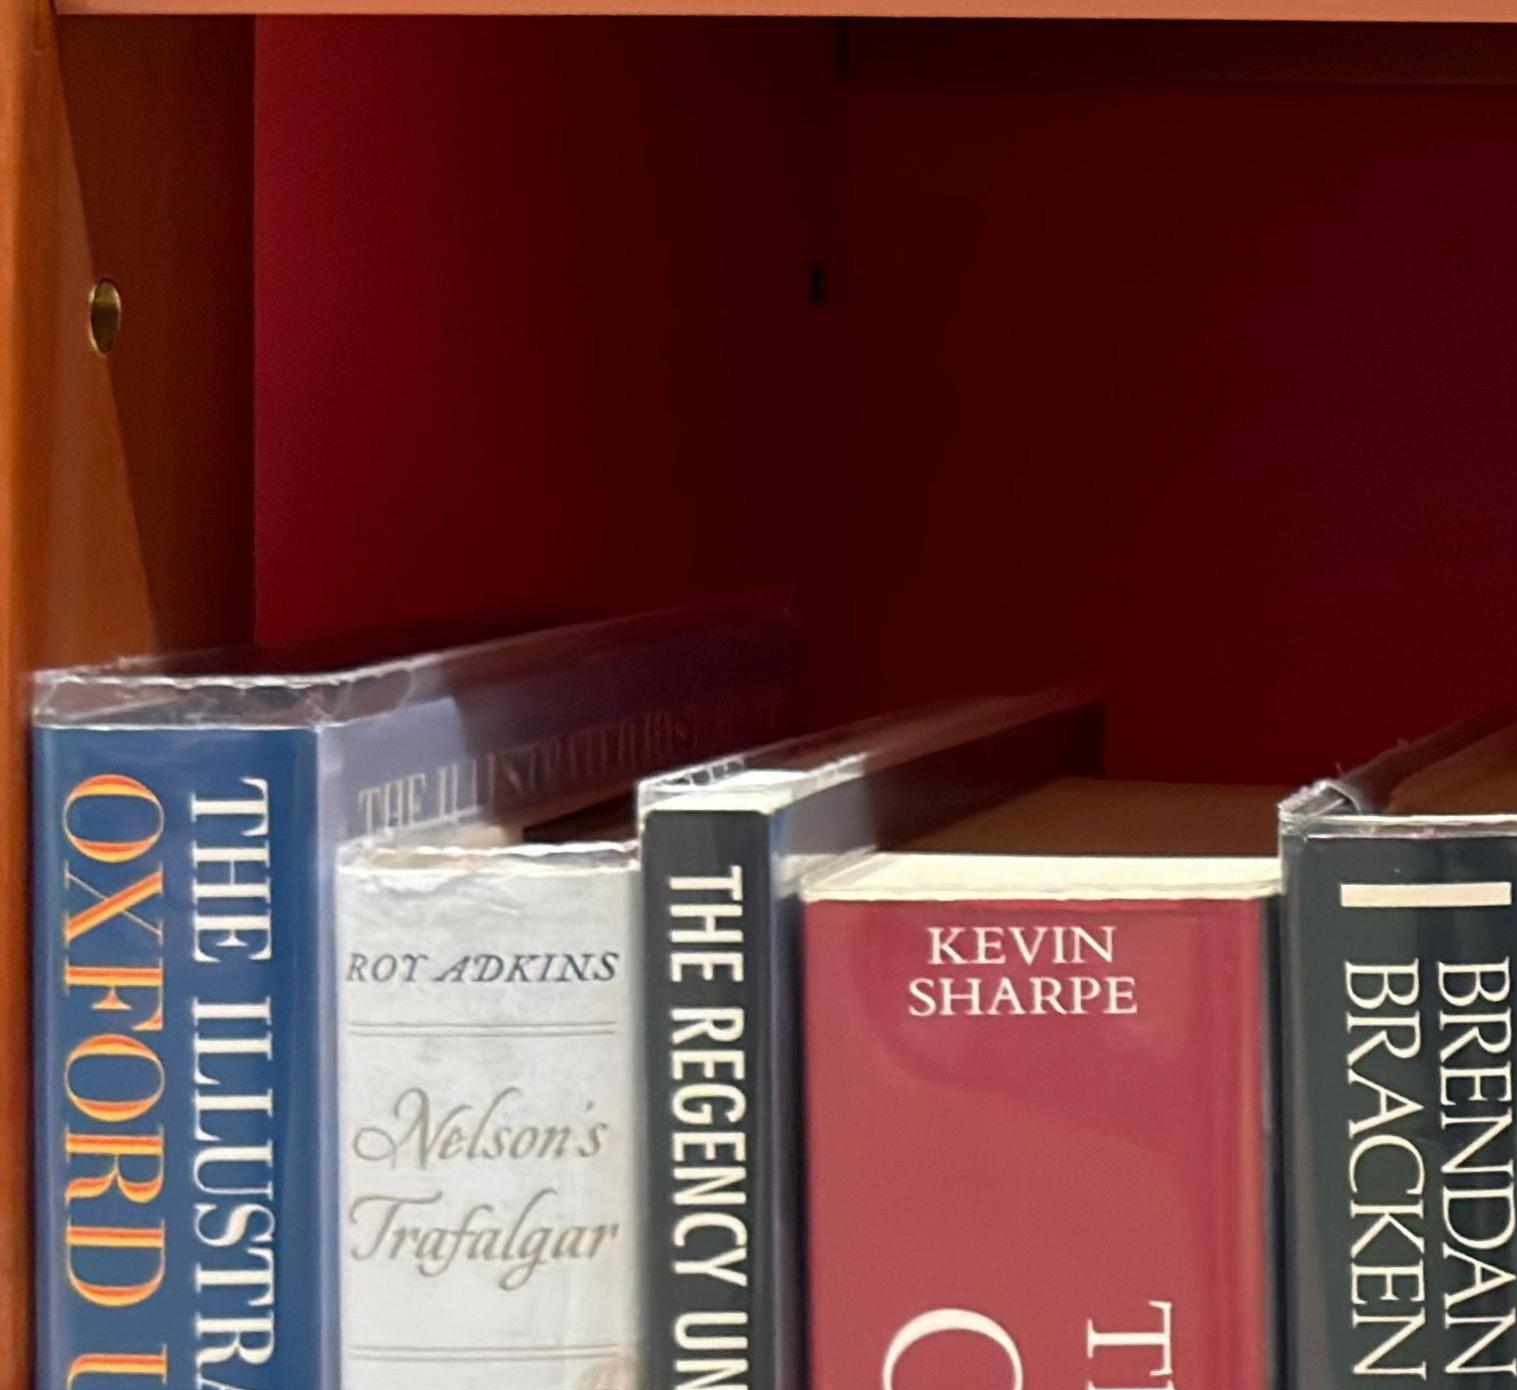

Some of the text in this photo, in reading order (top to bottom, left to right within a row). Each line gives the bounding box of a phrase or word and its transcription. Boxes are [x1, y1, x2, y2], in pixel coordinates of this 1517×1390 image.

[190, 778, 270, 963] THE
[669, 865, 742, 982] THE
[346, 951, 618, 983] ROY ADKINS
[909, 977, 1138, 1017] SHARPE
[926, 926, 1116, 964] KEVIN
[63, 774, 165, 1308] OXFORD
[352, 1087, 606, 1170] Nelson's
[670, 1009, 746, 1287] REGENCY
[1343, 958, 1427, 1381] BRACKEN
[1438, 958, 1517, 1378] BRENDAN
[348, 1195, 618, 1289] Trafalgar
